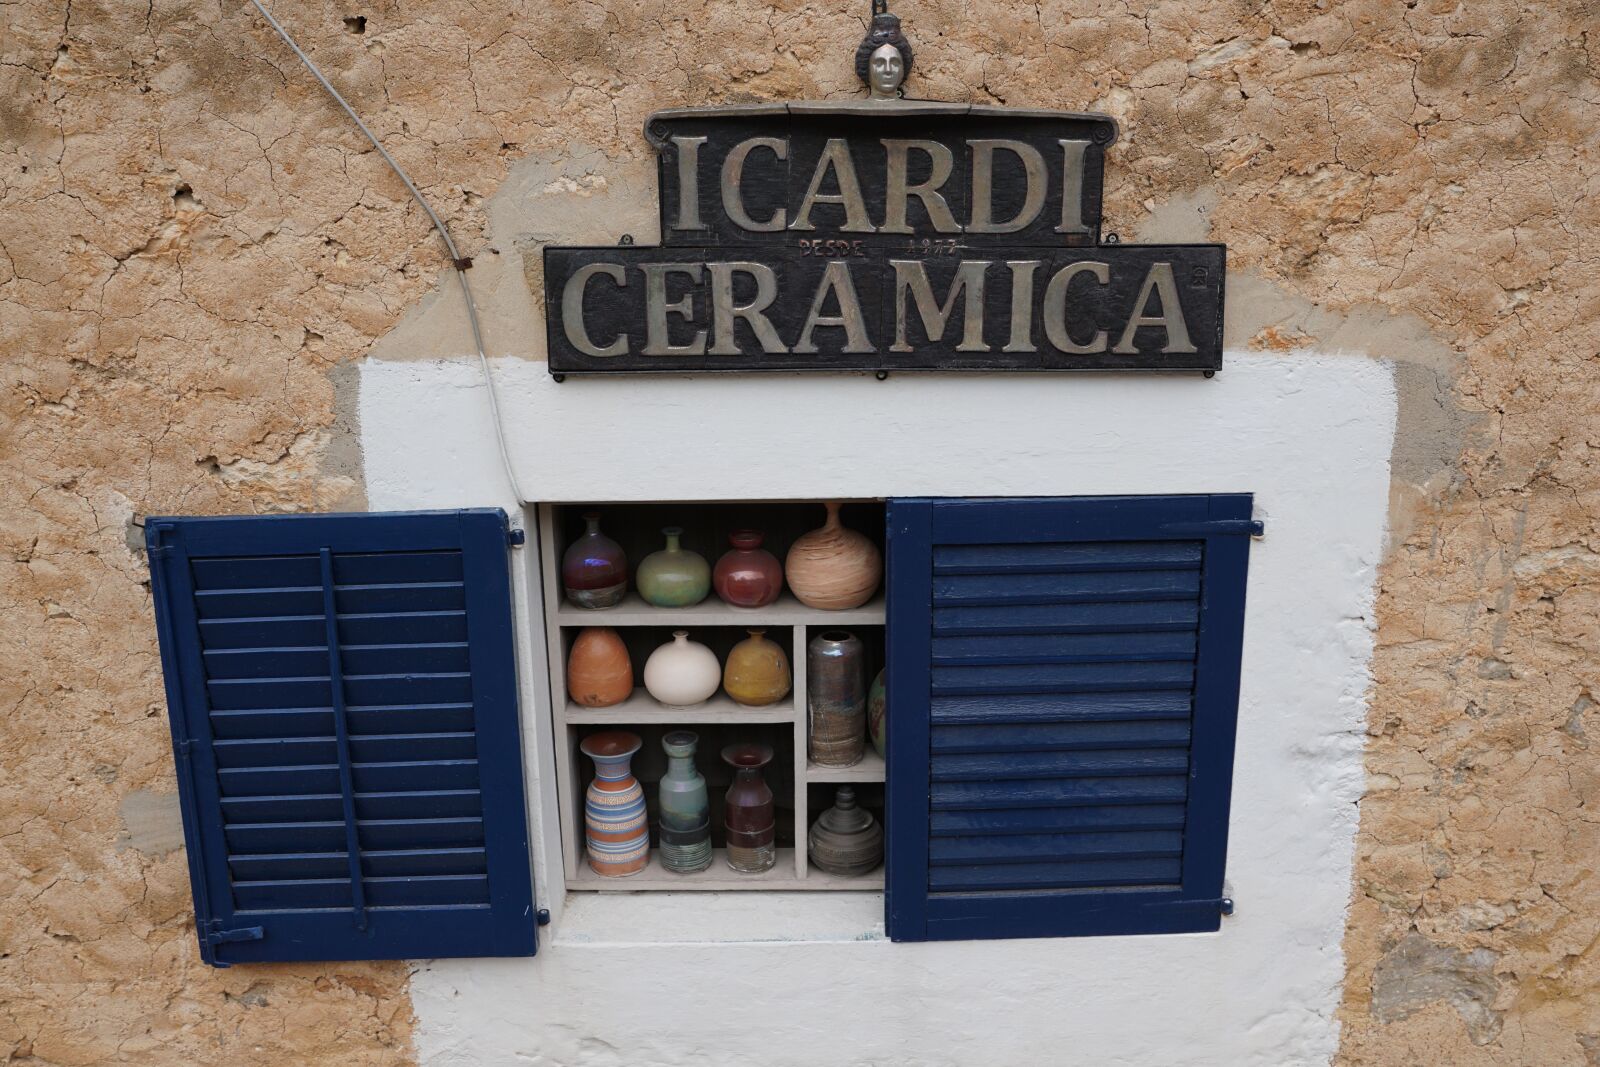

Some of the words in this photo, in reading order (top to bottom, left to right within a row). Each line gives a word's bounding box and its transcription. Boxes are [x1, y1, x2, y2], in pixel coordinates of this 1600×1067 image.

[671, 136, 1091, 233] ICARDI
[799, 239, 864, 257] DESDE
[562, 260, 1198, 356] CERAMICA
